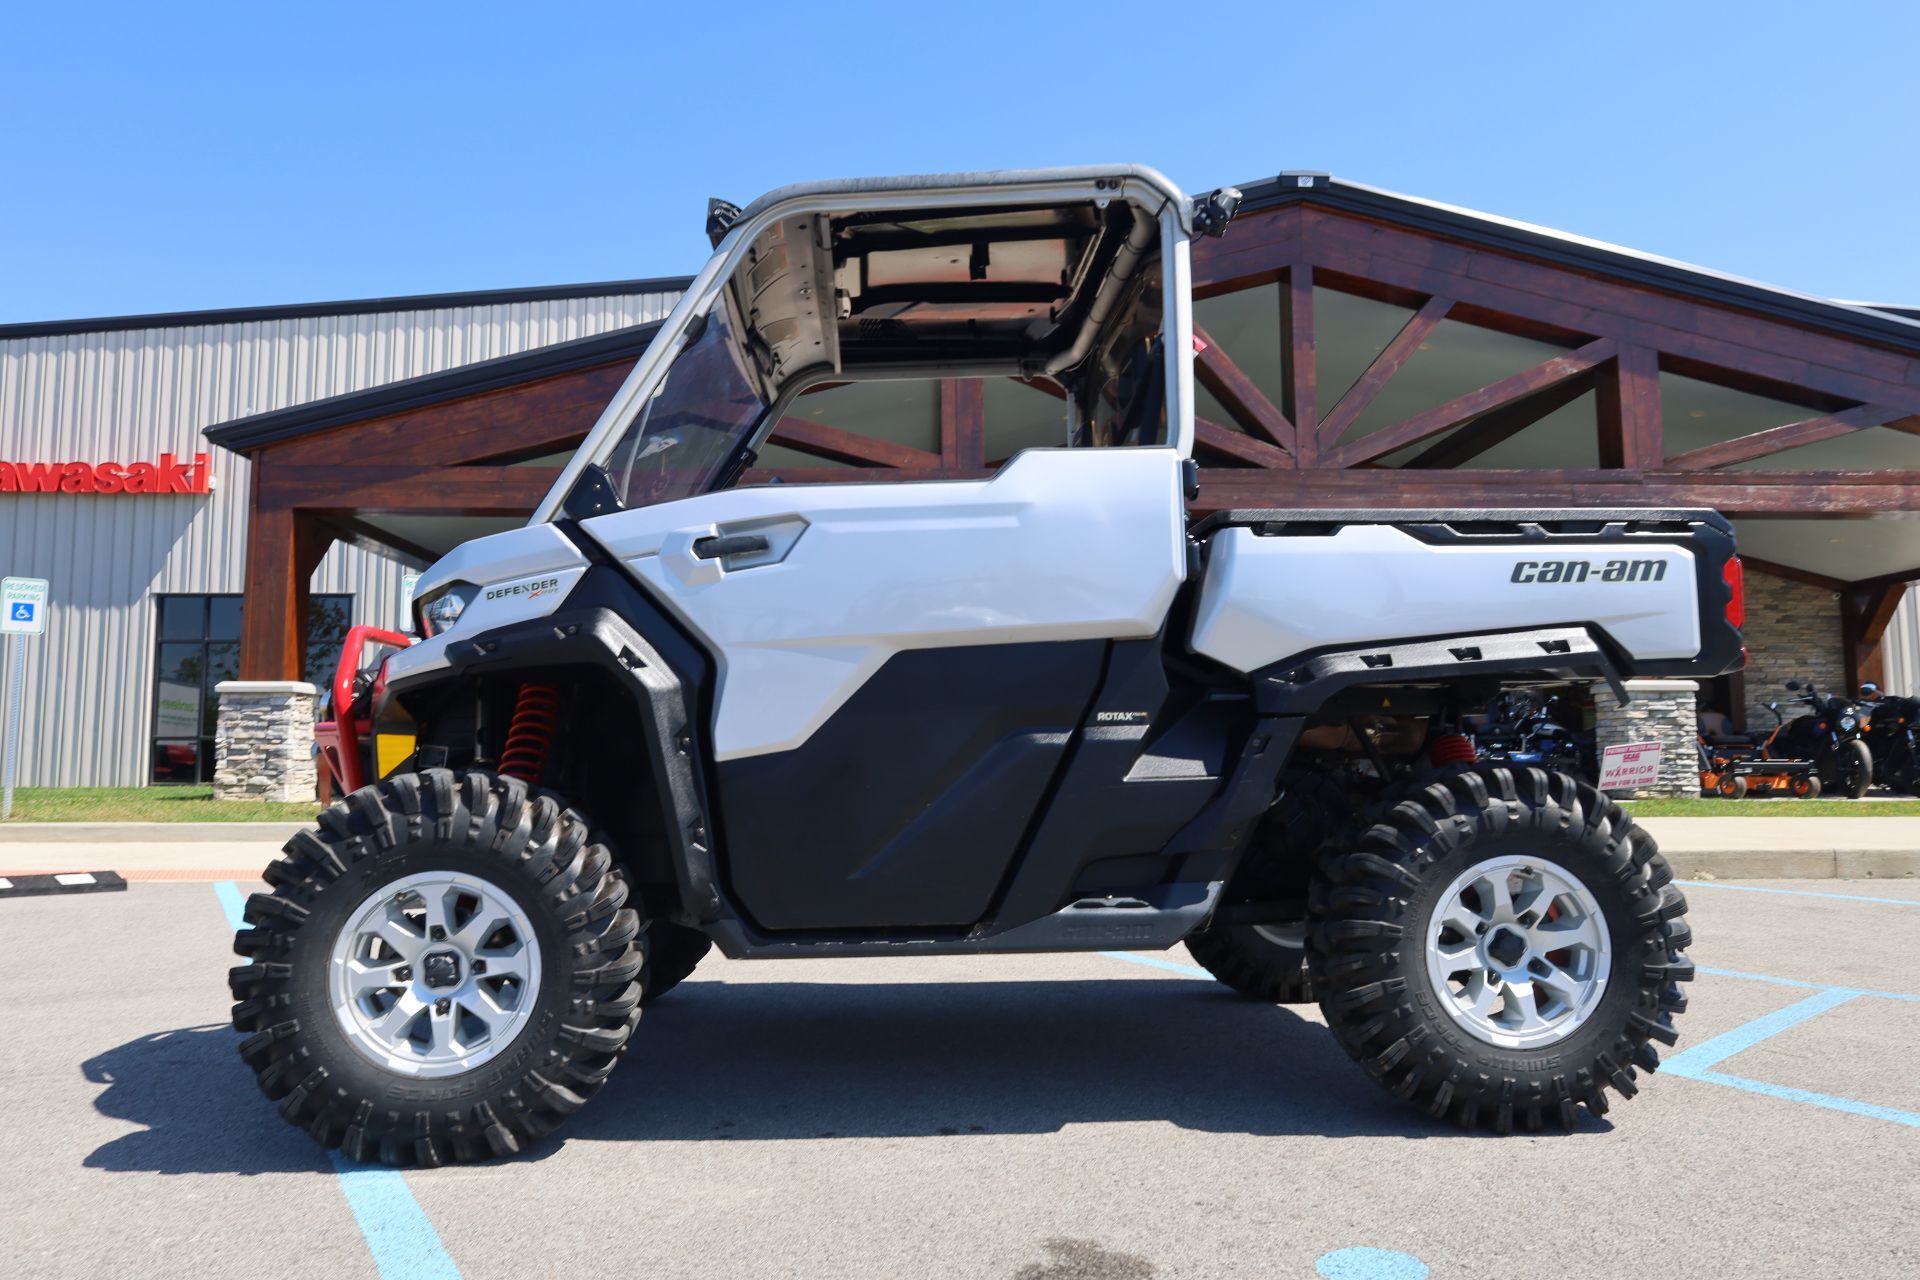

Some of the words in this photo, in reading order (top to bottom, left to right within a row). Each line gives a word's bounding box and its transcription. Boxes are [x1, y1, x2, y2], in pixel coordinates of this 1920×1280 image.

[1510, 559, 1668, 584] can-am
[486, 579, 559, 601] DEFENDER
[1097, 711, 1133, 721] ROTAX
[1605, 765, 1653, 777] WARRIOR
